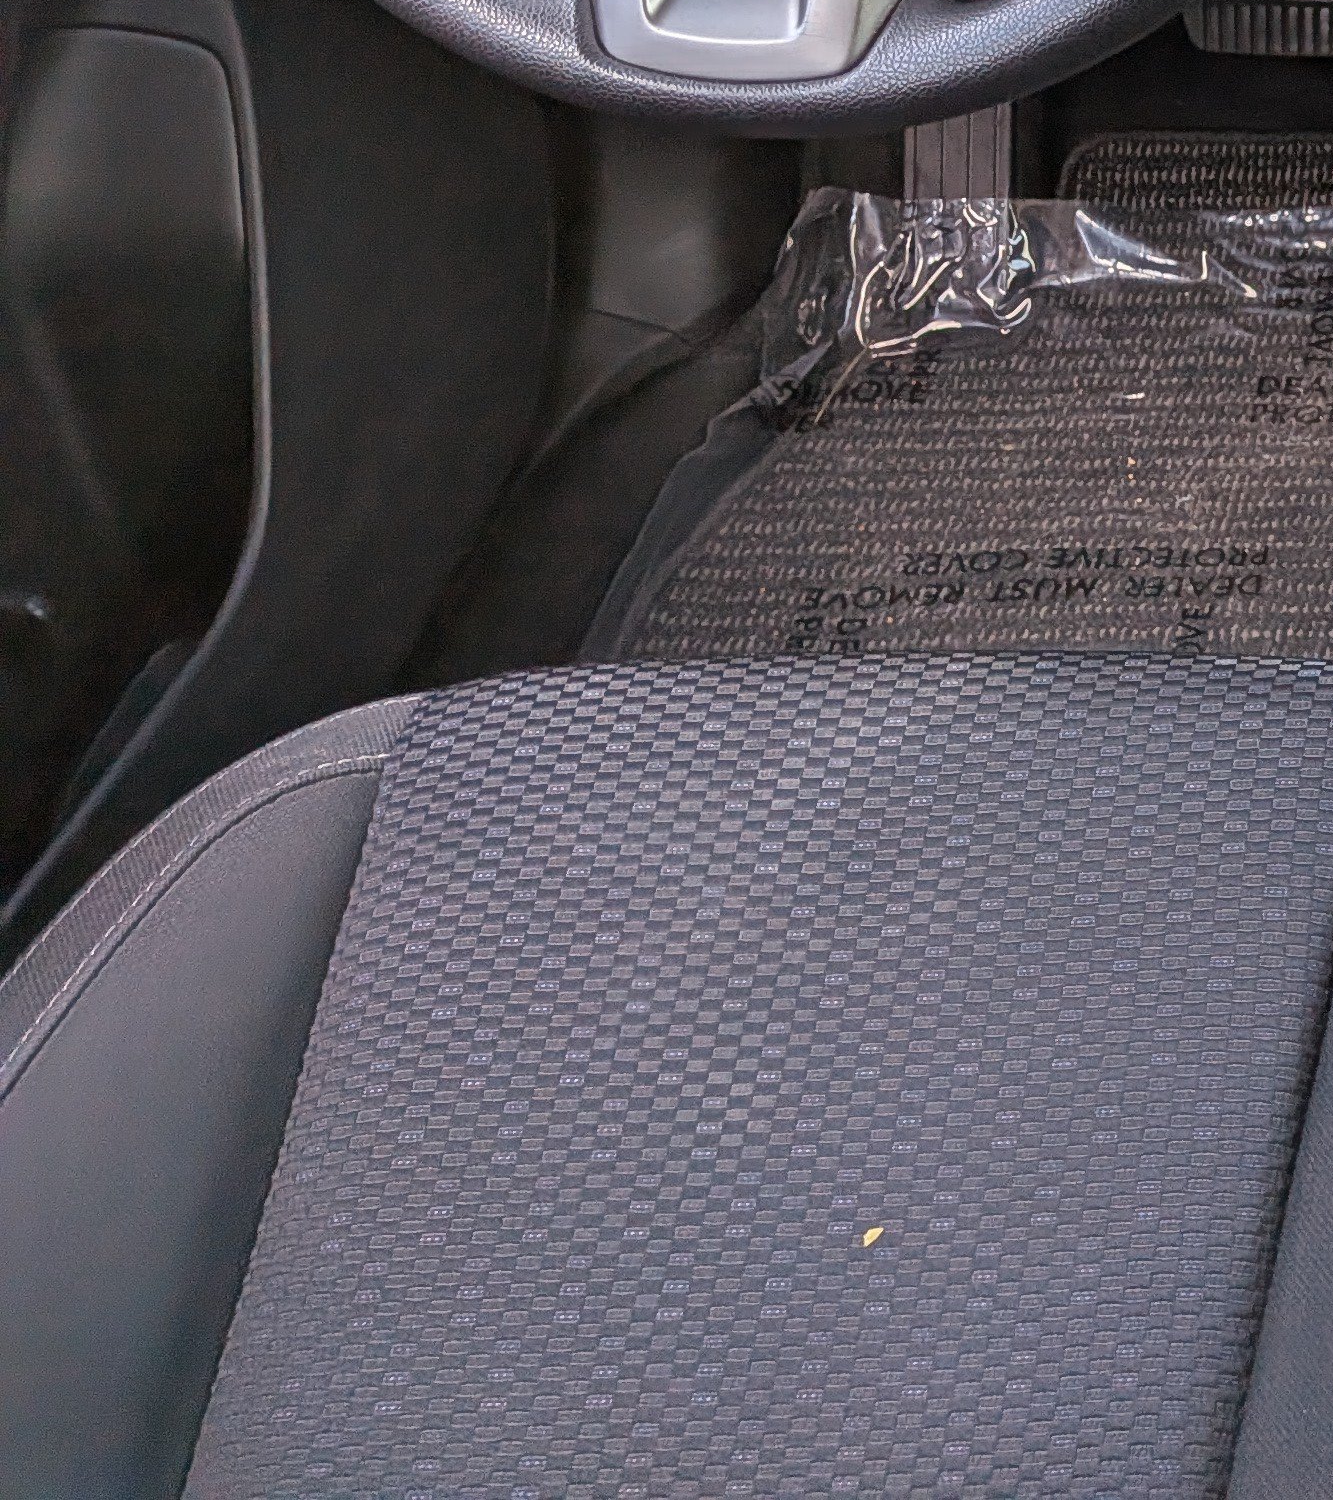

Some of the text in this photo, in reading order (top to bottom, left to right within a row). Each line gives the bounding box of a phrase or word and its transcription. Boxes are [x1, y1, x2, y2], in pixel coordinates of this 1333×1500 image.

[901, 545, 1272, 576] PROTECTIVE COVER
[800, 573, 1264, 611] DEALER MUST REMOVE
